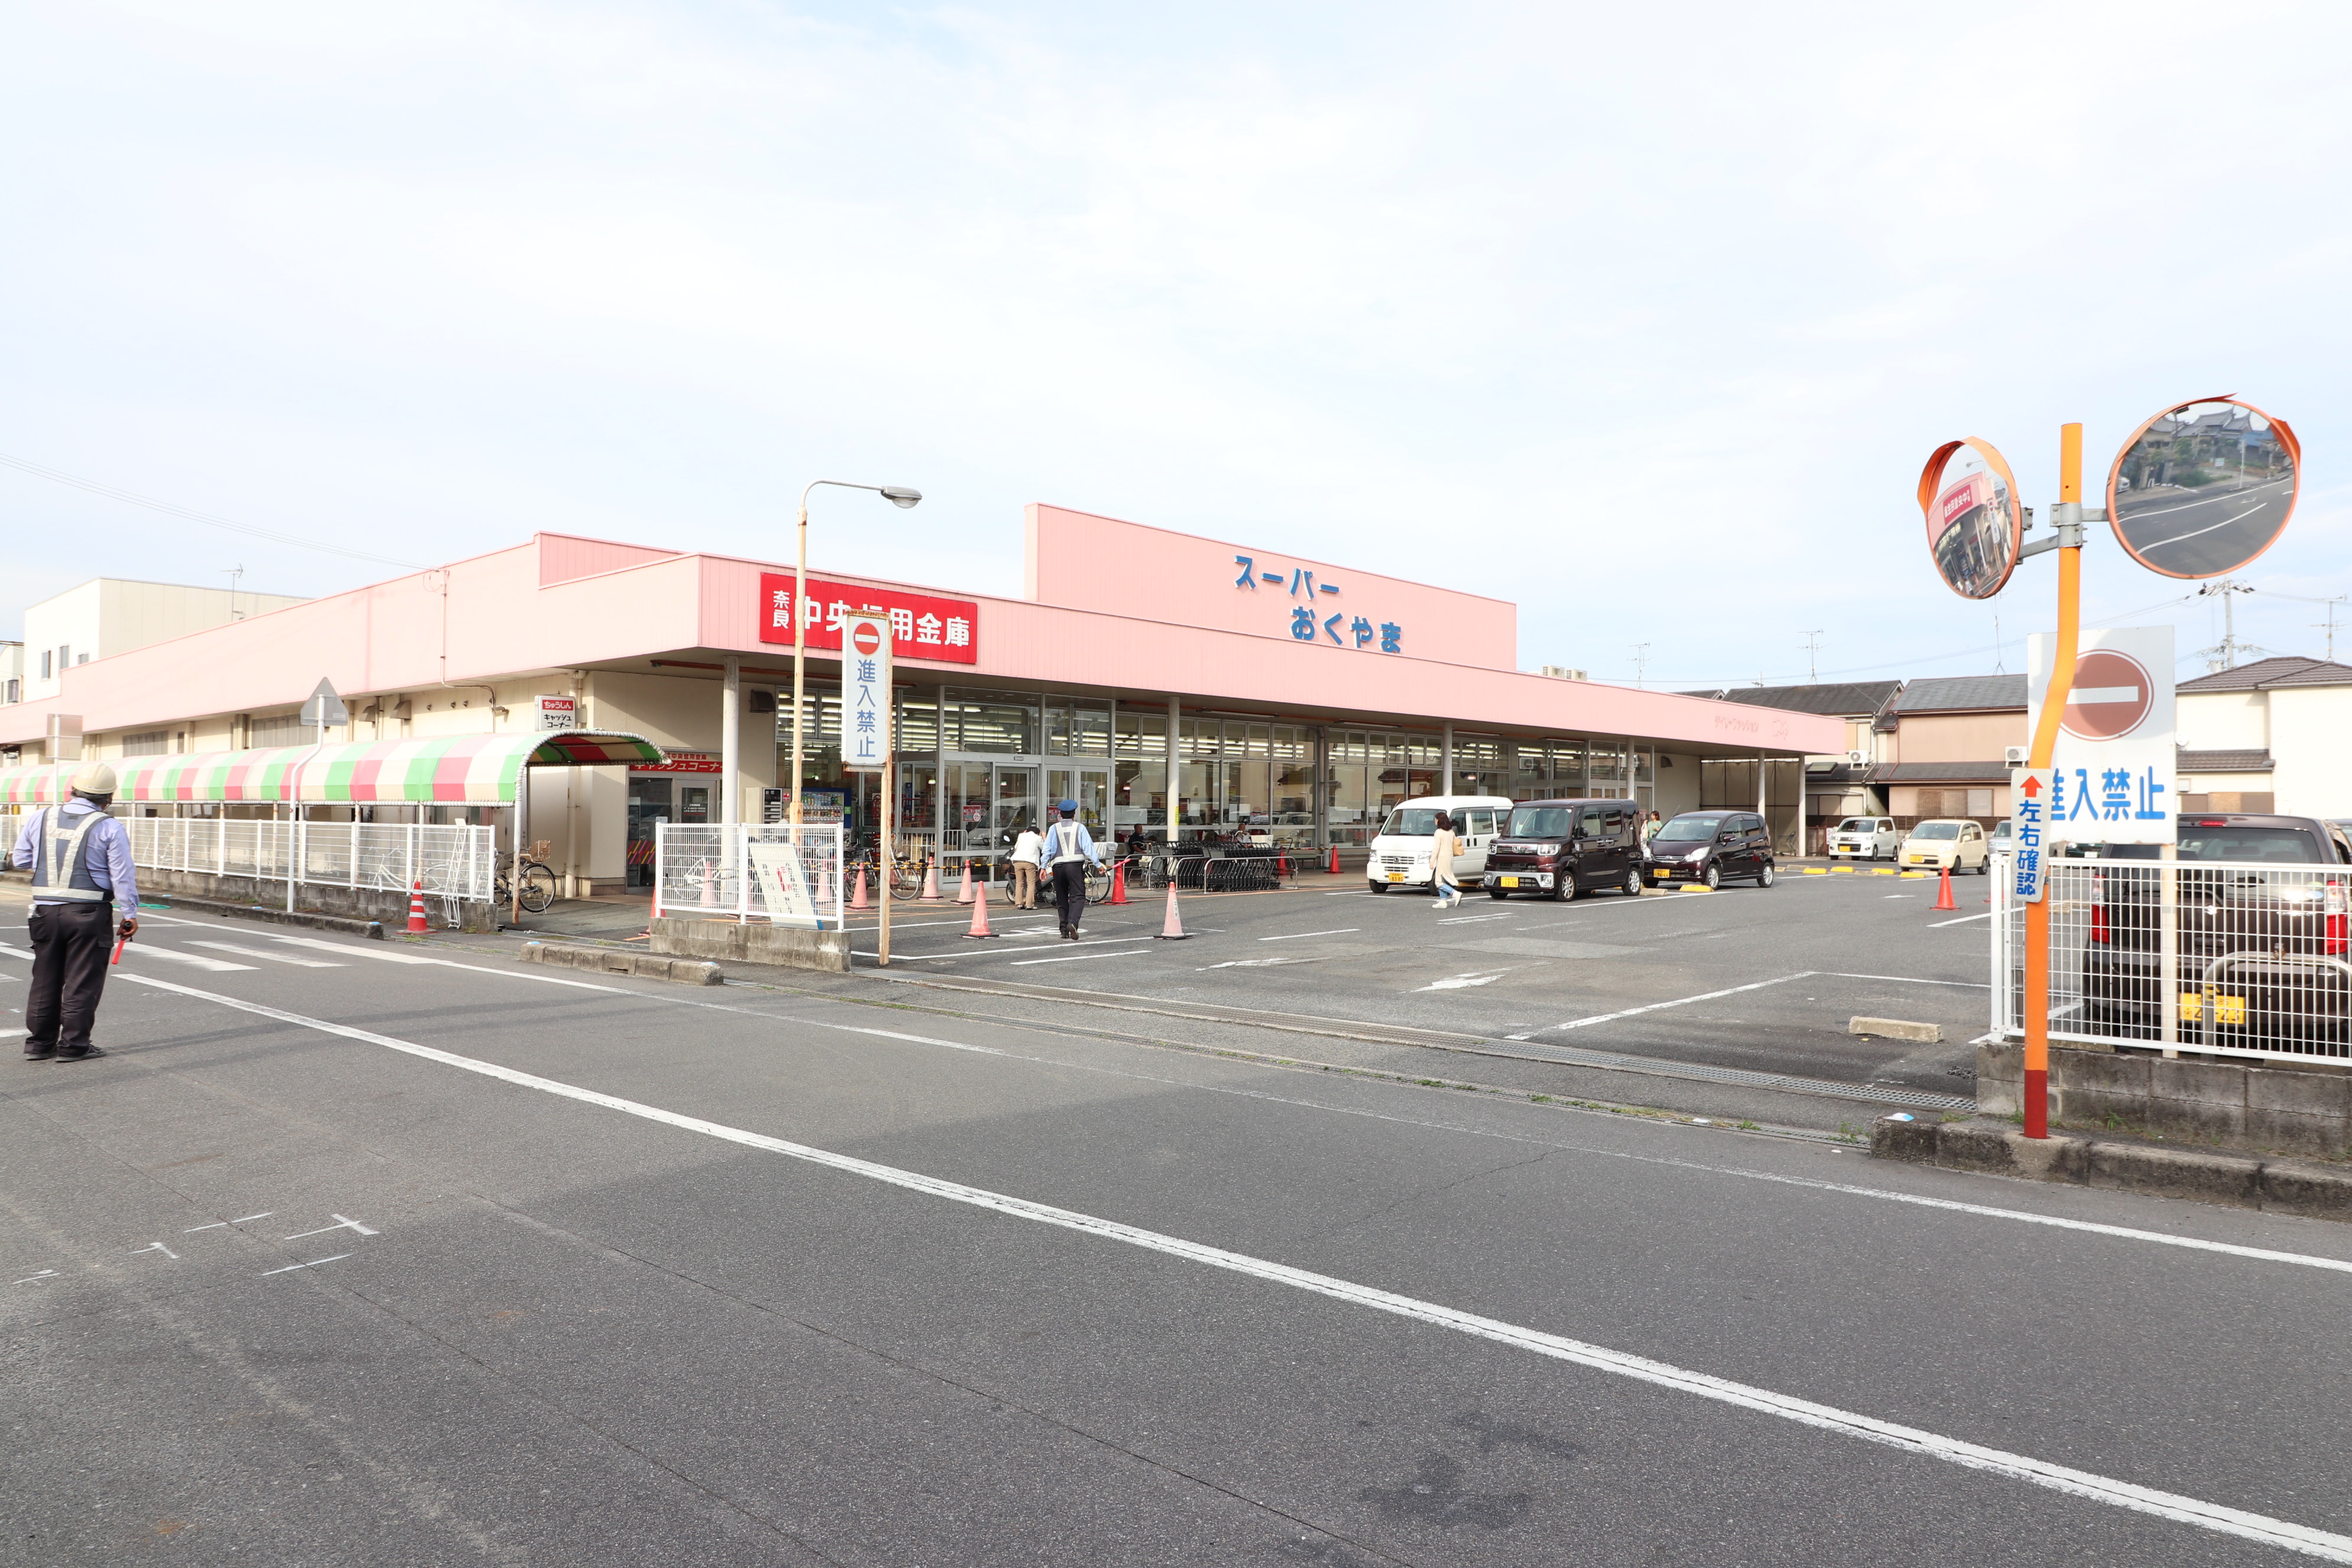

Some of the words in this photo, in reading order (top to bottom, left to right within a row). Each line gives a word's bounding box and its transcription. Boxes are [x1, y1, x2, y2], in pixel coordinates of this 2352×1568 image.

[1233, 555, 1339, 600] スーパー
[773, 590, 790, 629] 奈良
[795, 596, 970, 647] 中央用金庫
[1289, 606, 1402, 654] おくやま
[857, 659, 876, 757] 進入禁止
[2016, 800, 2042, 896] 左右確認
